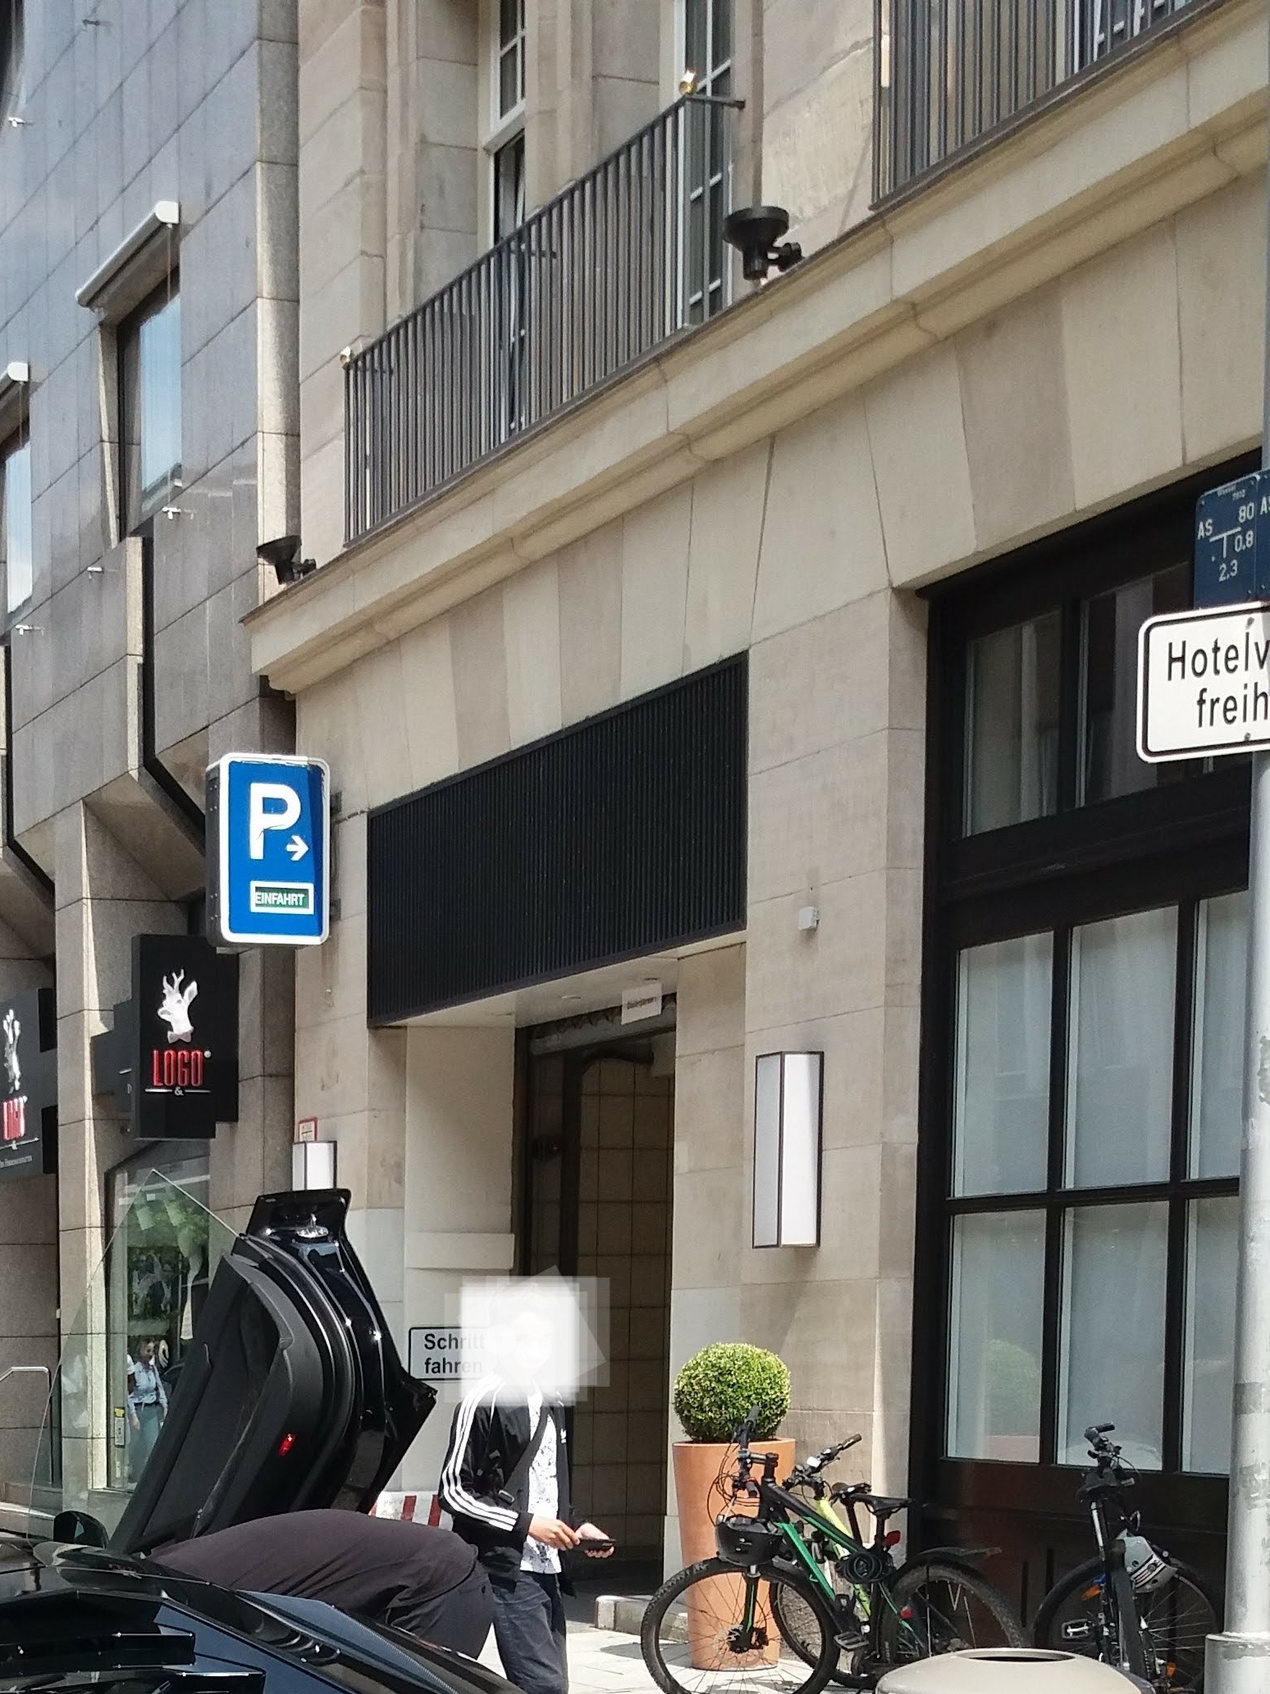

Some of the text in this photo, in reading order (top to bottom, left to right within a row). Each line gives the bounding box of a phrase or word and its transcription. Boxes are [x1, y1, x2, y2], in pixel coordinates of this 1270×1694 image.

[1238, 502, 1255, 523] 80
[1260, 496, 1270, 515] A
[1197, 519, 1213, 541] AS
[1196, 681, 1269, 728] freih
[249, 782, 302, 860] P
[254, 892, 306, 907] EINFAHRT
[153, 1049, 204, 1087] LOGO
[174, 1086, 184, 1096] &
[424, 1333, 485, 1350] Schritt
[424, 1357, 483, 1374] fahren
